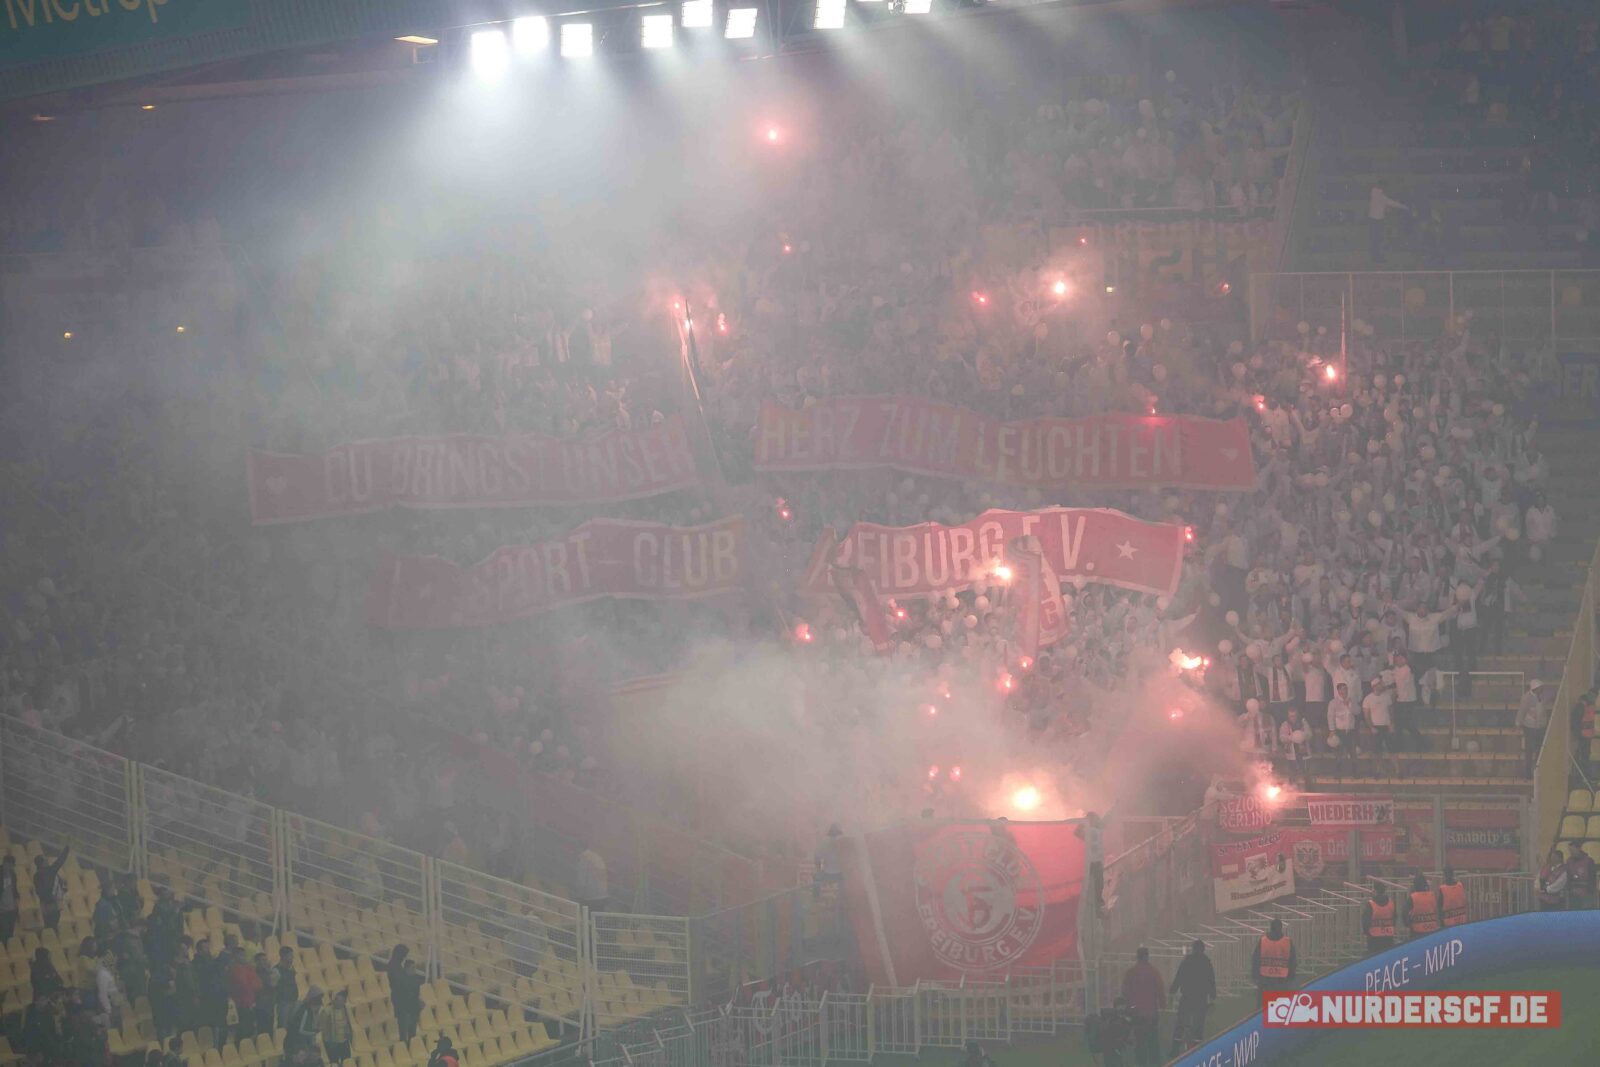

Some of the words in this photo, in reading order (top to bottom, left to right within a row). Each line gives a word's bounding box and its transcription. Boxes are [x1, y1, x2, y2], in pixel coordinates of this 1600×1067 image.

[760, 404, 863, 463] HERZ
[880, 402, 961, 465] ZUM
[977, 420, 1183, 481] LEUCHTEN
[1366, 957, 1410, 998] PEACE
